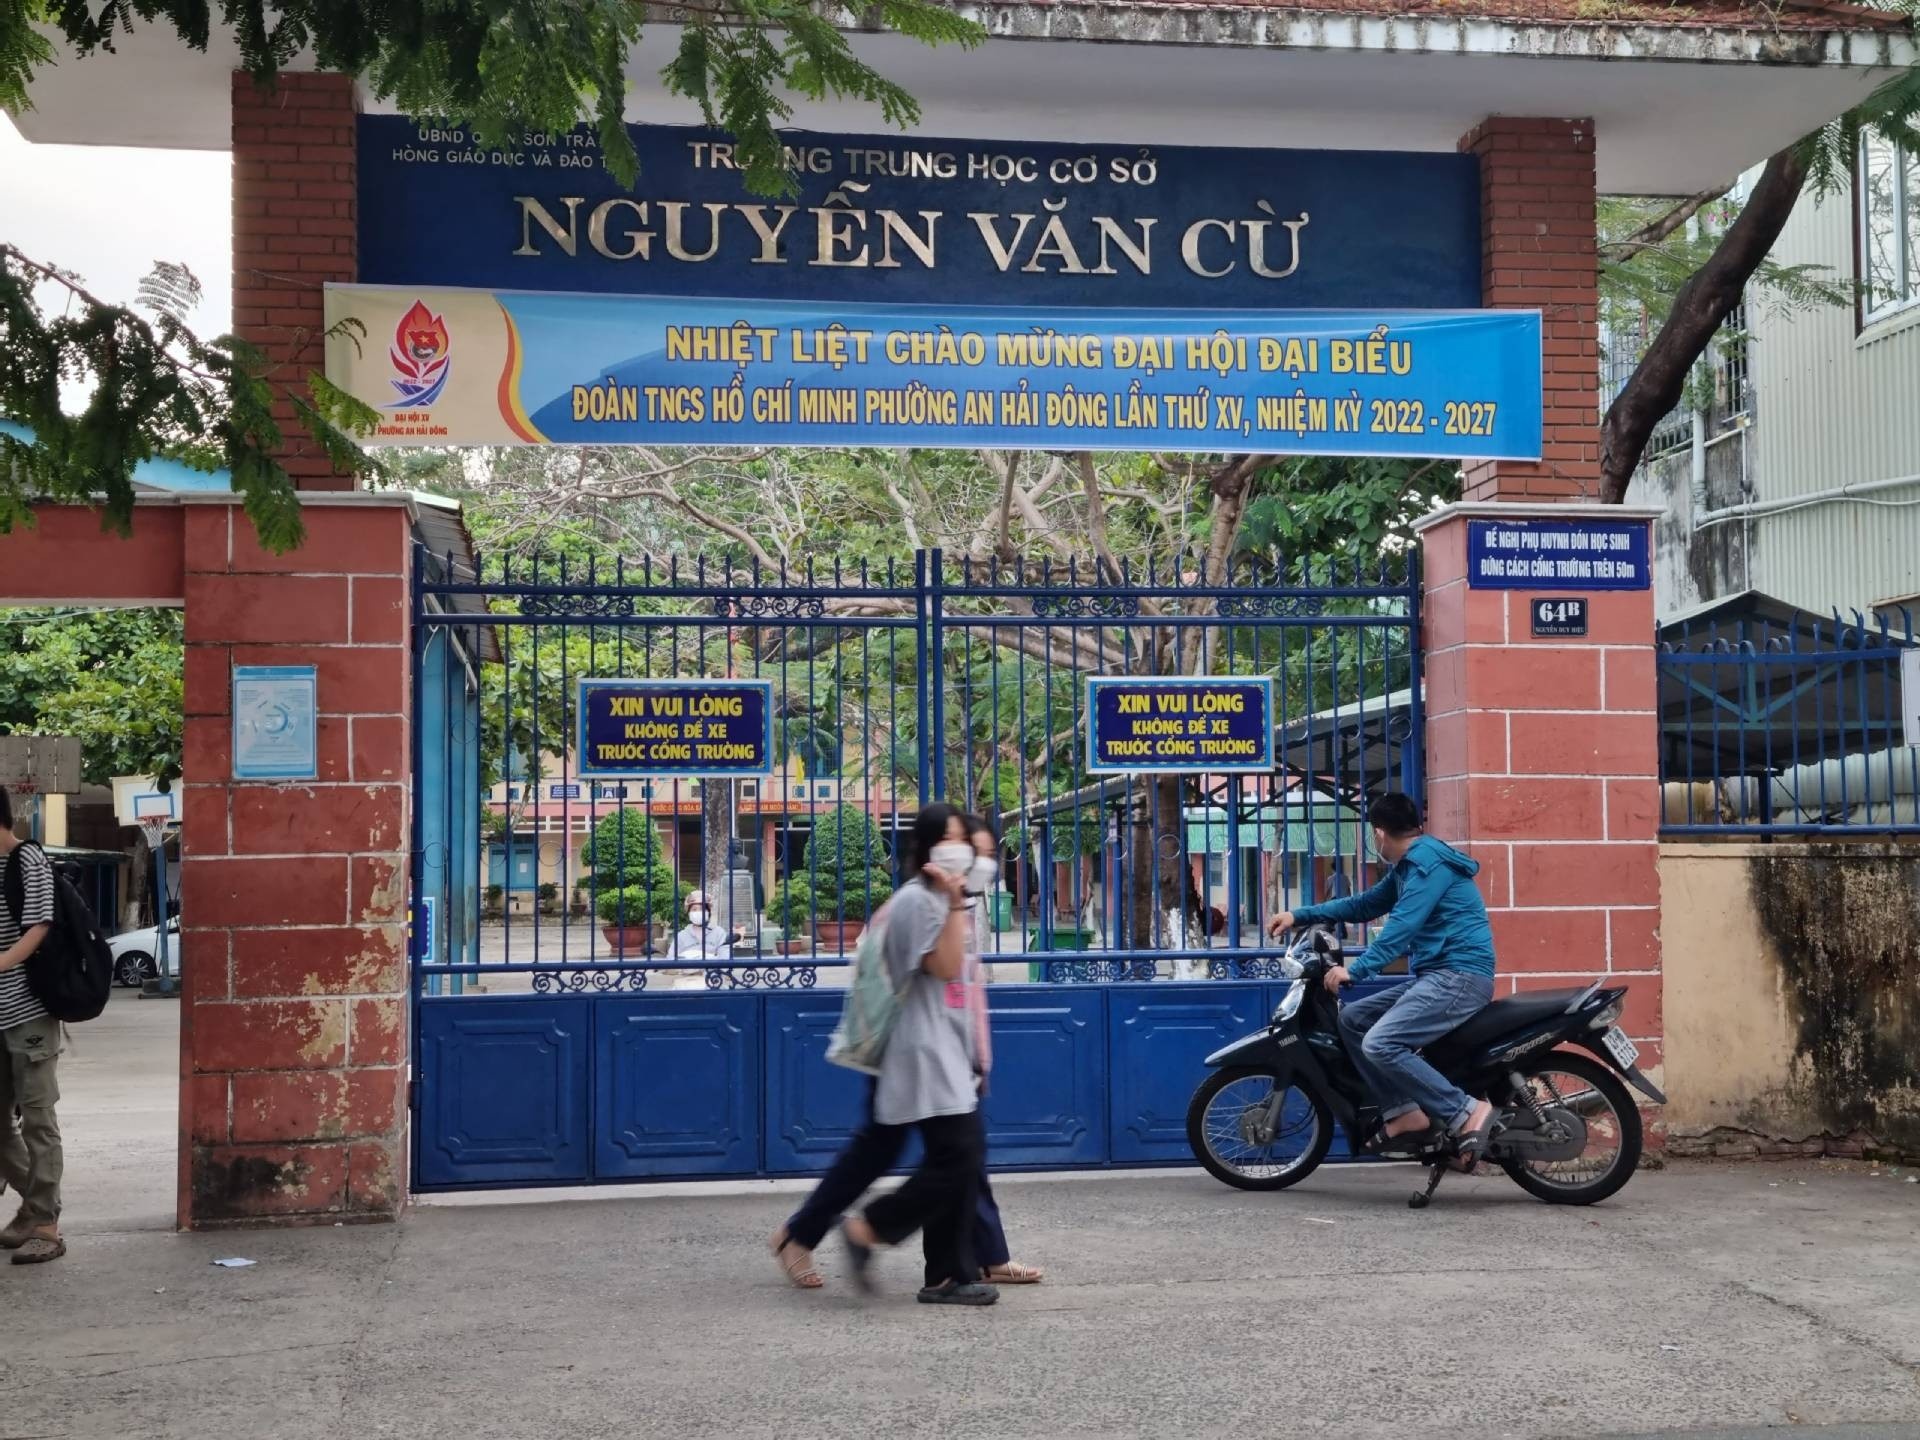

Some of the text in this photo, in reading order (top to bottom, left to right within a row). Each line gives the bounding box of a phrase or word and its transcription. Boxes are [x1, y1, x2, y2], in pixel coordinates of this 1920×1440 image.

[419, 129, 464, 143] UBND
[565, 131, 597, 147] TRÀ
[393, 144, 439, 162] HÒNG
[447, 147, 486, 164] GIÁO
[532, 149, 552, 166] VÀ
[559, 149, 593, 168] ĐÀO
[687, 141, 1158, 187] TRNG TRUNG HỌC CƠ SỞ
[512, 180, 1310, 279] NGUYỄN VĂN CỪ
[666, 319, 1412, 380] NHIỆT LIỆT CHÀO MỪNG ĐẠI HỘI ĐẠI BIỂU
[408, 411, 420, 423] HỘI
[421, 413, 430, 422] XV
[571, 371, 1497, 439] ĐOÀN TNCS HỒ CHÍ MINH PHƯỜNG AN HẢI ĐÔNG LẦN THỨ XV, NHIỆM KỲ 2022 - 2027
[378, 424, 448, 435] PHƯỜNG AN HẢI ĐÔNG
[1499, 531, 1520, 552] NGHỊ
[1521, 531, 1539, 552] PHỤ
[1540, 532, 1569, 550] HUYNH
[1571, 529, 1589, 550] ĐÓN
[1590, 532, 1608, 553] HỌC
[1609, 533, 1630, 551] SINH
[1481, 554, 1635, 579] ĐỨNG CÁCH CỔNG TRƯỜNG TRÊN 50m
[1539, 602, 1580, 622] 64B
[610, 693, 743, 717] XIN VUI LÒNG
[1117, 690, 1244, 714] XIN VUI LÒNG
[624, 718, 727, 739] KHÔNG ĐỂ XE
[1132, 714, 1230, 735] KHÔNG ĐỂ XE
[597, 738, 755, 760] TRƯỚC CỔNG TRƯỜNG
[1106, 735, 1256, 756] TRƯỚC CỔNG TRƯỜNG
